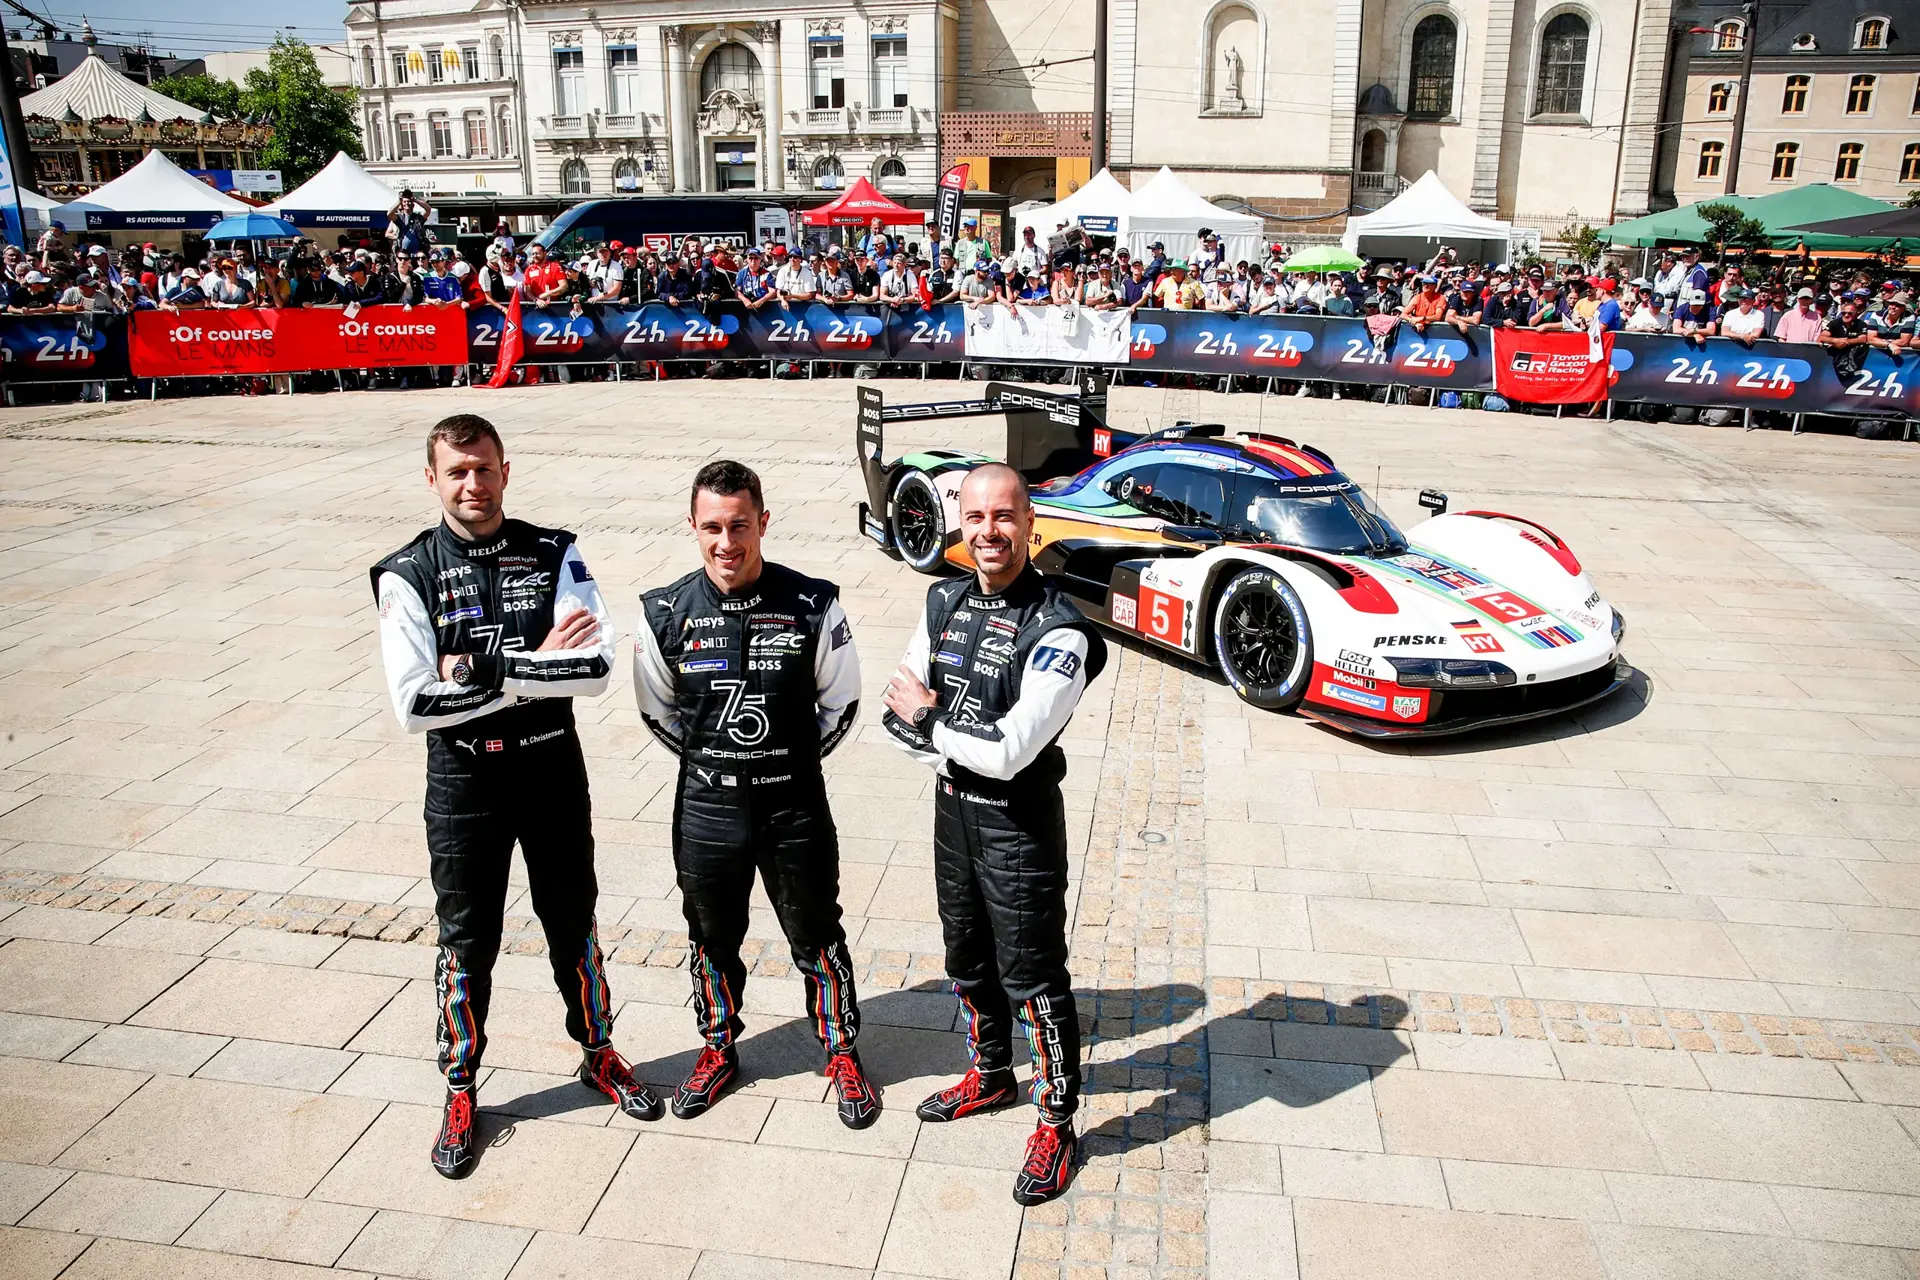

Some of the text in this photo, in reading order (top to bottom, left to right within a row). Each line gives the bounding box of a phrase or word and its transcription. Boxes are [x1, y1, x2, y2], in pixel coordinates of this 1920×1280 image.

[207, 327, 274, 341] course
[374, 323, 436, 336] course
[213, 341, 276, 358] MANS
[379, 335, 437, 353] MANS
[1511, 359, 1546, 373] GR
[1547, 366, 1585, 374] Racing
[1000, 391, 1080, 417] PORSCHE
[863, 407, 880, 420] BOSS
[1049, 412, 1080, 427] 963
[1094, 433, 1110, 453] HY
[468, 538, 509, 557] HELLER
[501, 571, 551, 588] WEC
[439, 587, 465, 603] Mobil
[721, 594, 763, 611] HELLER
[503, 599, 536, 613] BOSS
[967, 597, 1007, 610] HELLER
[1114, 596, 1135, 611] HYPER
[1482, 596, 1528, 616] 5
[774, 613, 796, 621] PENSKE
[1114, 605, 1134, 626] CAR
[1151, 593, 1170, 635] 5
[683, 616, 725, 631] Ansys
[684, 637, 715, 651] Mobil
[749, 632, 806, 648] WEC
[1373, 635, 1448, 648] PENSKE
[1464, 635, 1495, 651] HY
[748, 660, 782, 671] BOSS
[1340, 650, 1370, 666] BOSS
[515, 666, 591, 676] PORSCHE
[973, 661, 1000, 679] BOSS
[1334, 659, 1375, 677] HELLER
[1333, 670, 1364, 688] Mobil
[1340, 691, 1381, 706] MICHELIN
[1395, 698, 1418, 706] TAG
[710, 679, 770, 745] 75
[1395, 705, 1419, 716] HEUER
[519, 728, 565, 747] M. Christensen
[702, 747, 789, 760] PORSCHE
[752, 774, 792, 785] D. Cameron
